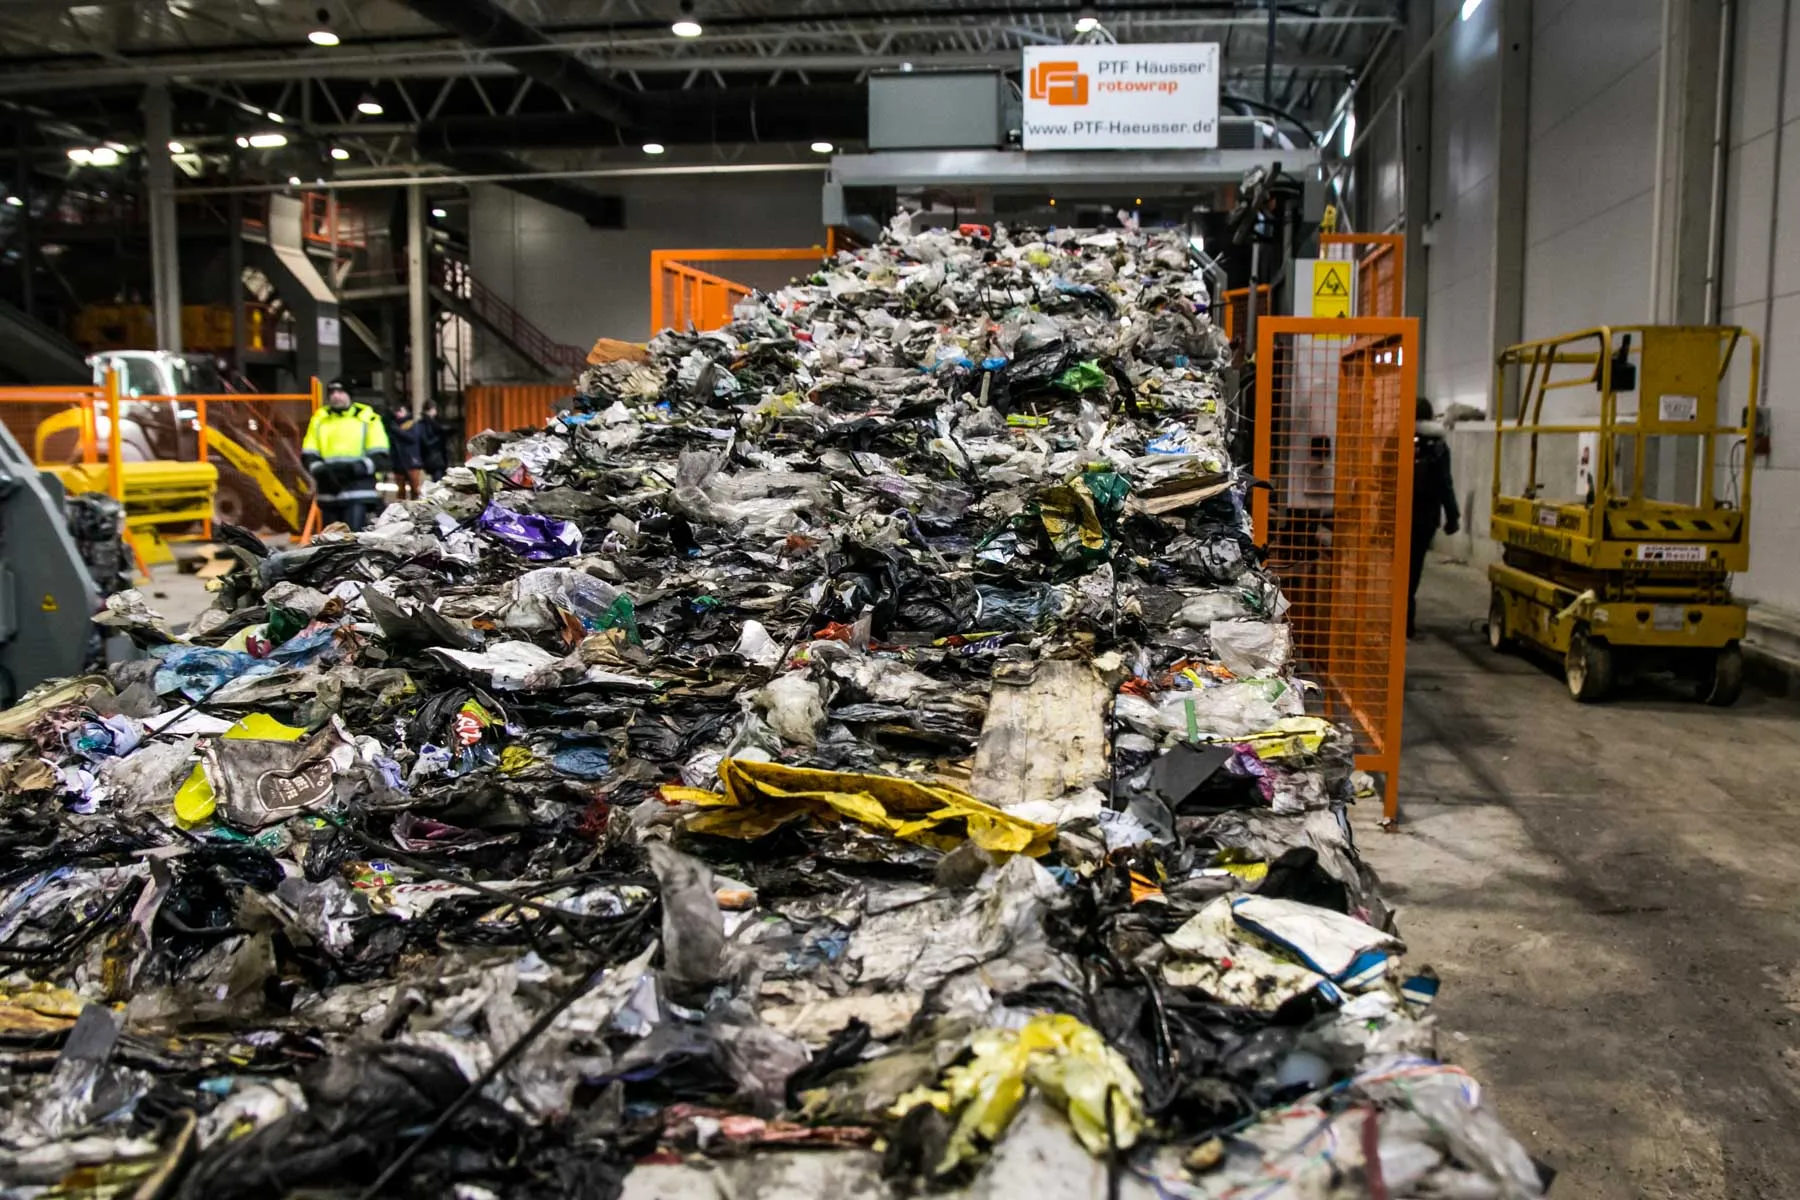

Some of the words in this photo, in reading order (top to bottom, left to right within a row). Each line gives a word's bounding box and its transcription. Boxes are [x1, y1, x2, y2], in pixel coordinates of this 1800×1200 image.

[1098, 60, 1129, 75] PTF
[1097, 80, 1179, 95] rotowrap
[1028, 120, 1212, 135] www.PTF-Haeusser.de
